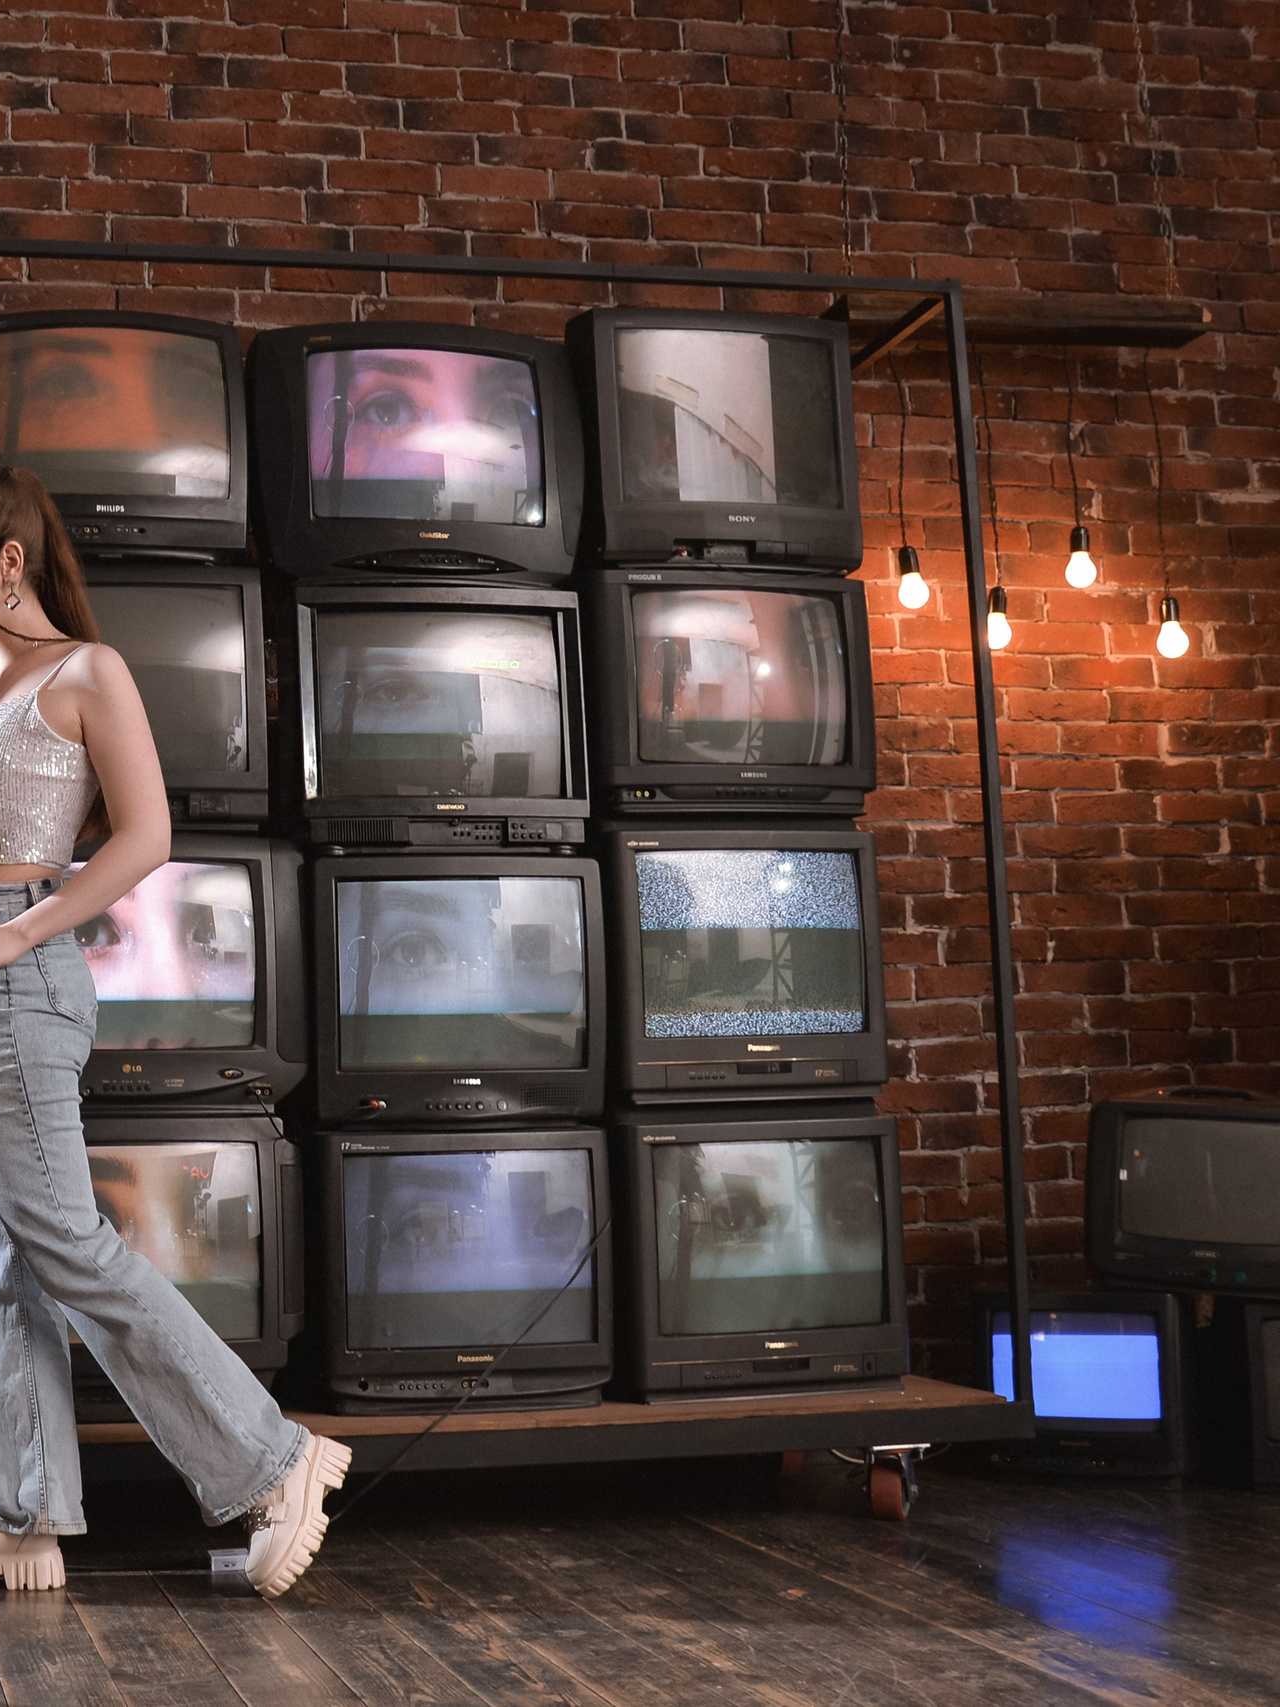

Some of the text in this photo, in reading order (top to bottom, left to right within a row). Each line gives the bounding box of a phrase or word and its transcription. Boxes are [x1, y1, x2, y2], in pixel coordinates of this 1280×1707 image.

[96, 504, 125, 512] PHILIPS
[728, 515, 756, 523] SONY
[457, 1354, 494, 1363] Panasonic
